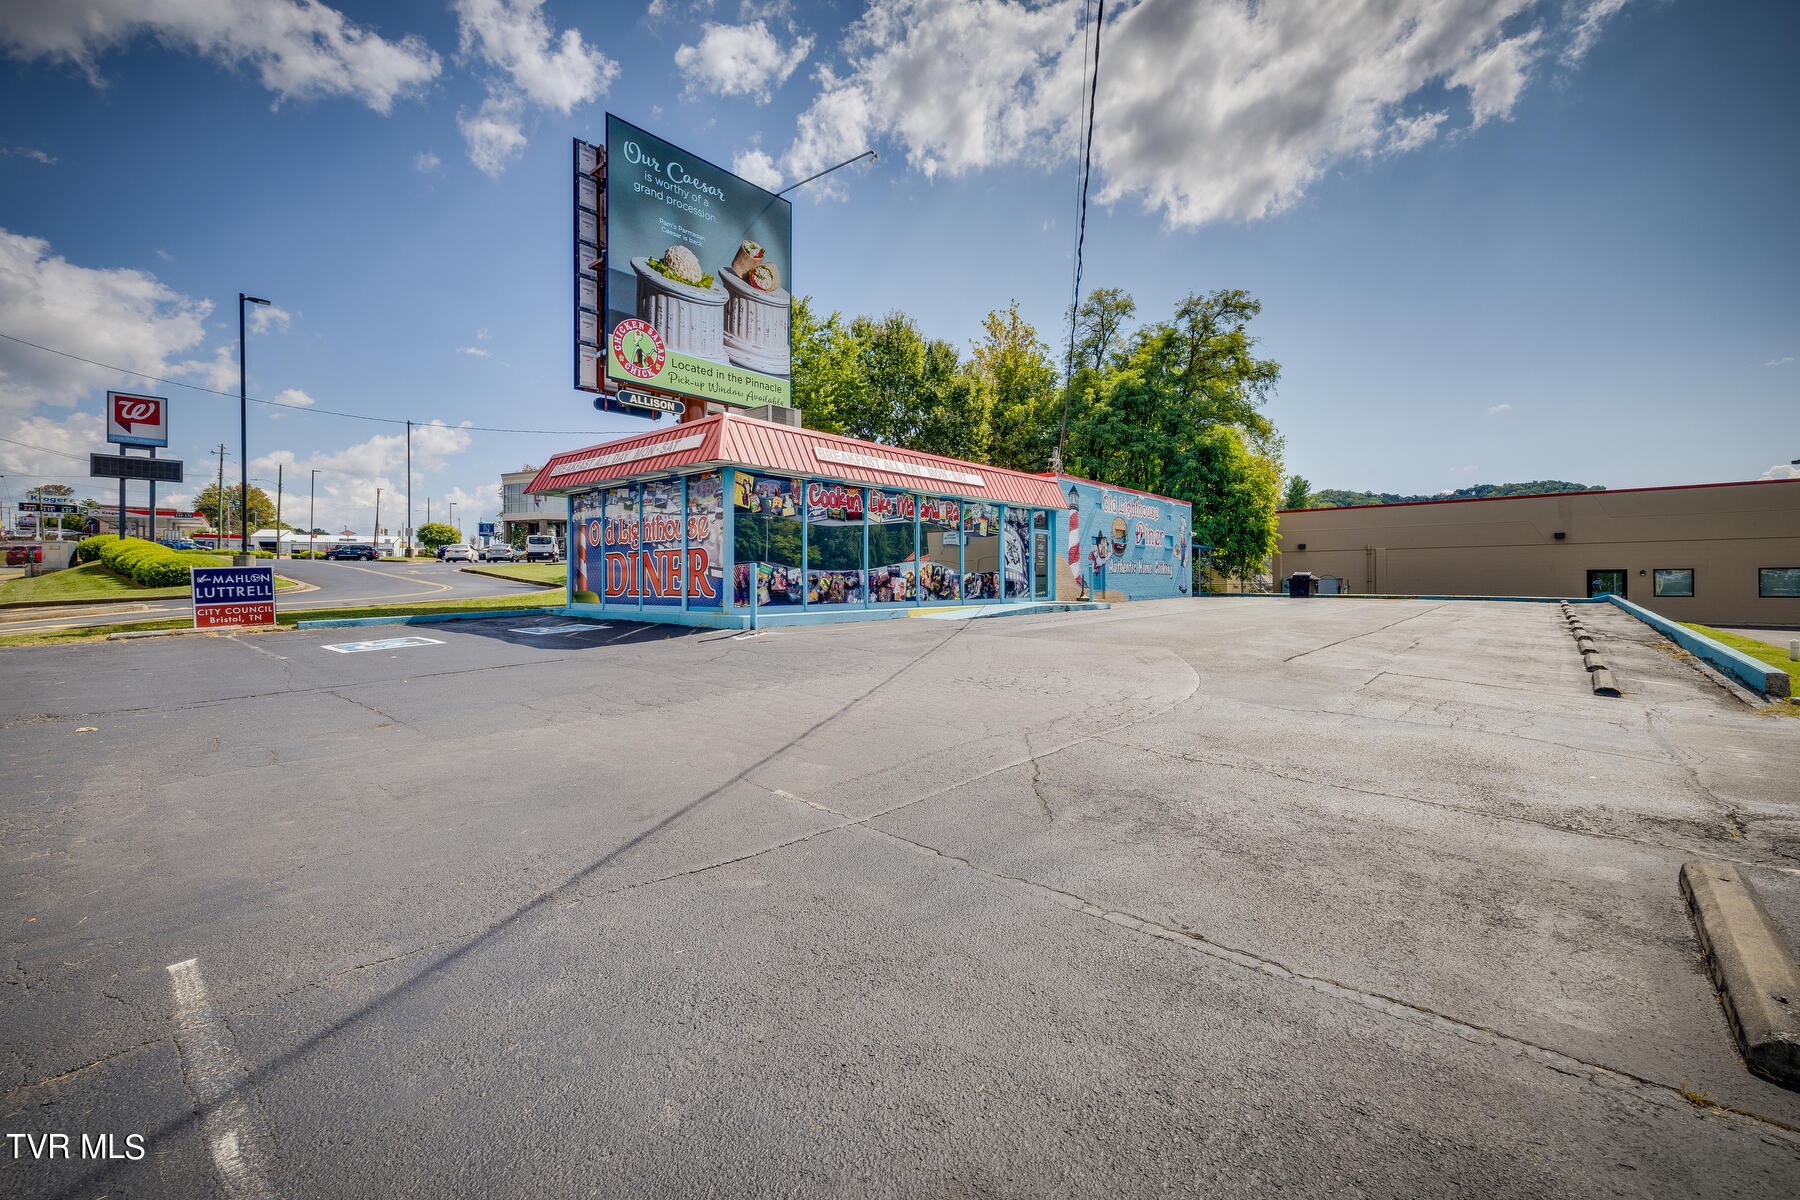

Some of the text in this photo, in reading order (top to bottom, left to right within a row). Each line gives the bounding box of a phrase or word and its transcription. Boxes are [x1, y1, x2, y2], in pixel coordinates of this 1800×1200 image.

[624, 140, 660, 172] Our
[667, 162, 726, 202] Caesar
[644, 170, 709, 207] is worthy of a
[633, 182, 719, 224] grand procession.
[661, 226, 682, 239] Caesar
[678, 226, 706, 242] Parmesan
[614, 321, 644, 351] CHICKEN
[648, 328, 664, 362] SALAD
[624, 363, 656, 377] CHICK
[671, 358, 782, 394] Located in the Pinnacle
[668, 371, 784, 407] Pick-up Window Available
[629, 394, 675, 411] ALLISON
[551, 458, 595, 476] BREAKFAST
[592, 456, 609, 466] ALL
[611, 451, 630, 463] DAY
[817, 448, 881, 468] BREAKFAST
[884, 461, 901, 471] ALL
[904, 464, 922, 475] DAY
[808, 485, 960, 521] Cookin Like Ma and Pa
[1102, 495, 1160, 521] Old Lighthouse
[589, 520, 615, 547] Od
[1135, 521, 1165, 549] Diner
[213, 574, 270, 584] MAHLON
[604, 548, 716, 599] DINER
[1108, 558, 1173, 579] Authentic Home Cooking
[196, 585, 272, 599] LUTTRELL
[197, 606, 272, 616] CITY COUNCIL
[210, 615, 245, 624] Bristol,
